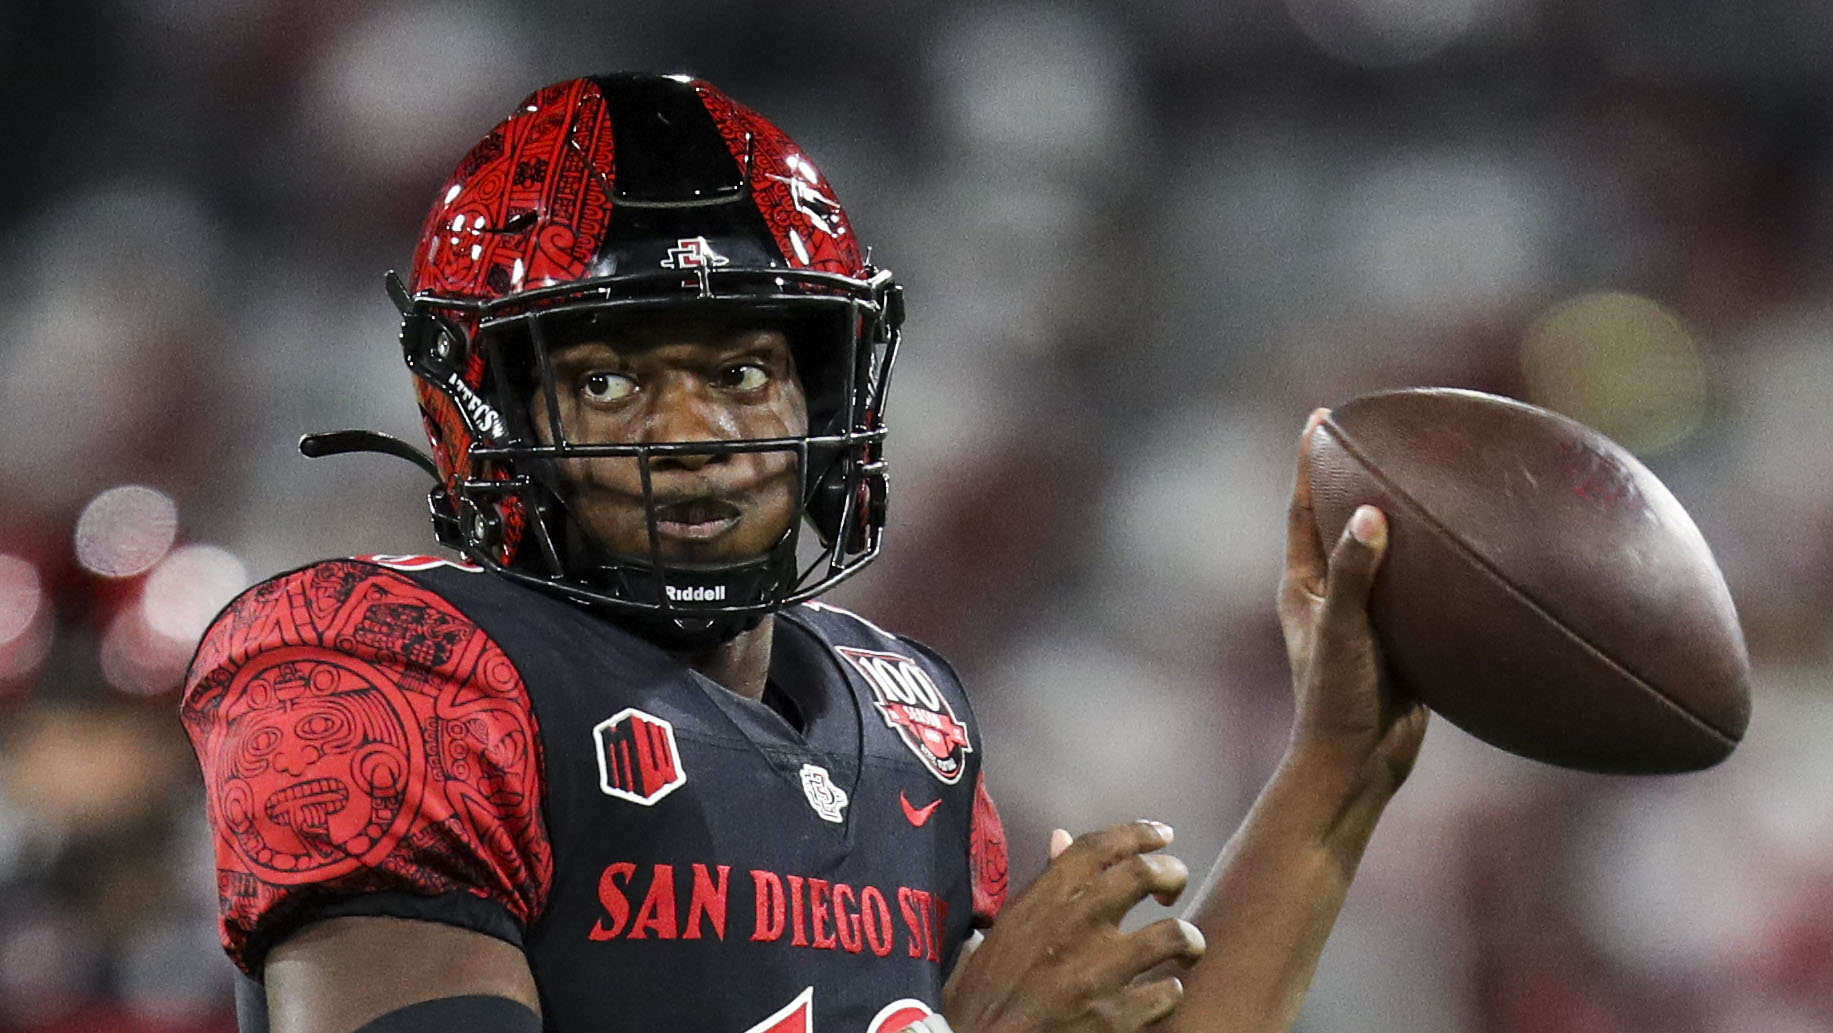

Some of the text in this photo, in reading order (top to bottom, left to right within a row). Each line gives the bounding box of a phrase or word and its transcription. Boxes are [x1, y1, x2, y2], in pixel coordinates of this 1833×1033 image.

[665, 585, 726, 601] Riddell
[858, 656, 940, 712] 100
[588, 862, 731, 942] SAN
[749, 870, 894, 957] DIEGO
